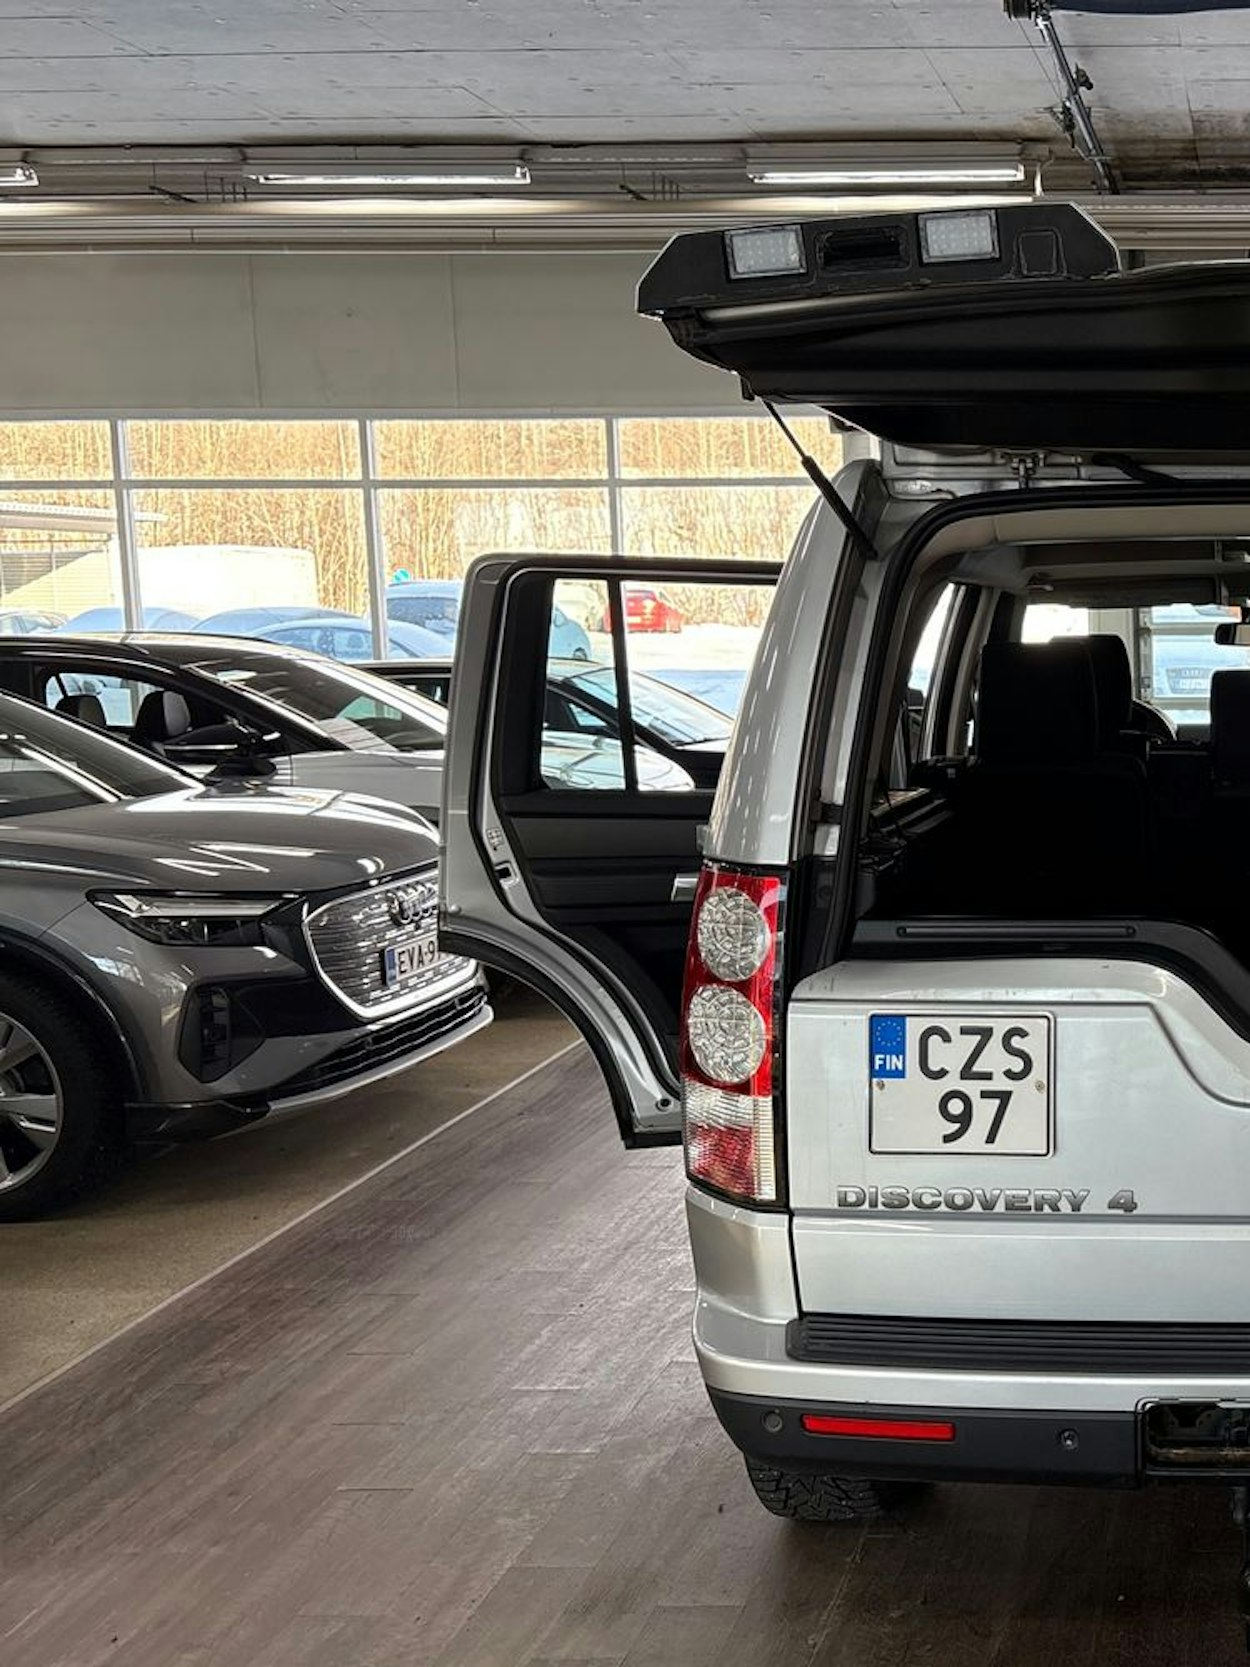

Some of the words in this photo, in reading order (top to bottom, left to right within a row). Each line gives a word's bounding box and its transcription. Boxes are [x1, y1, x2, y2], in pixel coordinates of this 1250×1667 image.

[398, 940, 441, 974] EVA-9
[874, 1054, 903, 1071] FIN
[918, 1025, 1034, 1081] CZS
[938, 1089, 1014, 1144] 97
[836, 1185, 1091, 1213] DISCOVERY
[1107, 1189, 1139, 1213] 4
